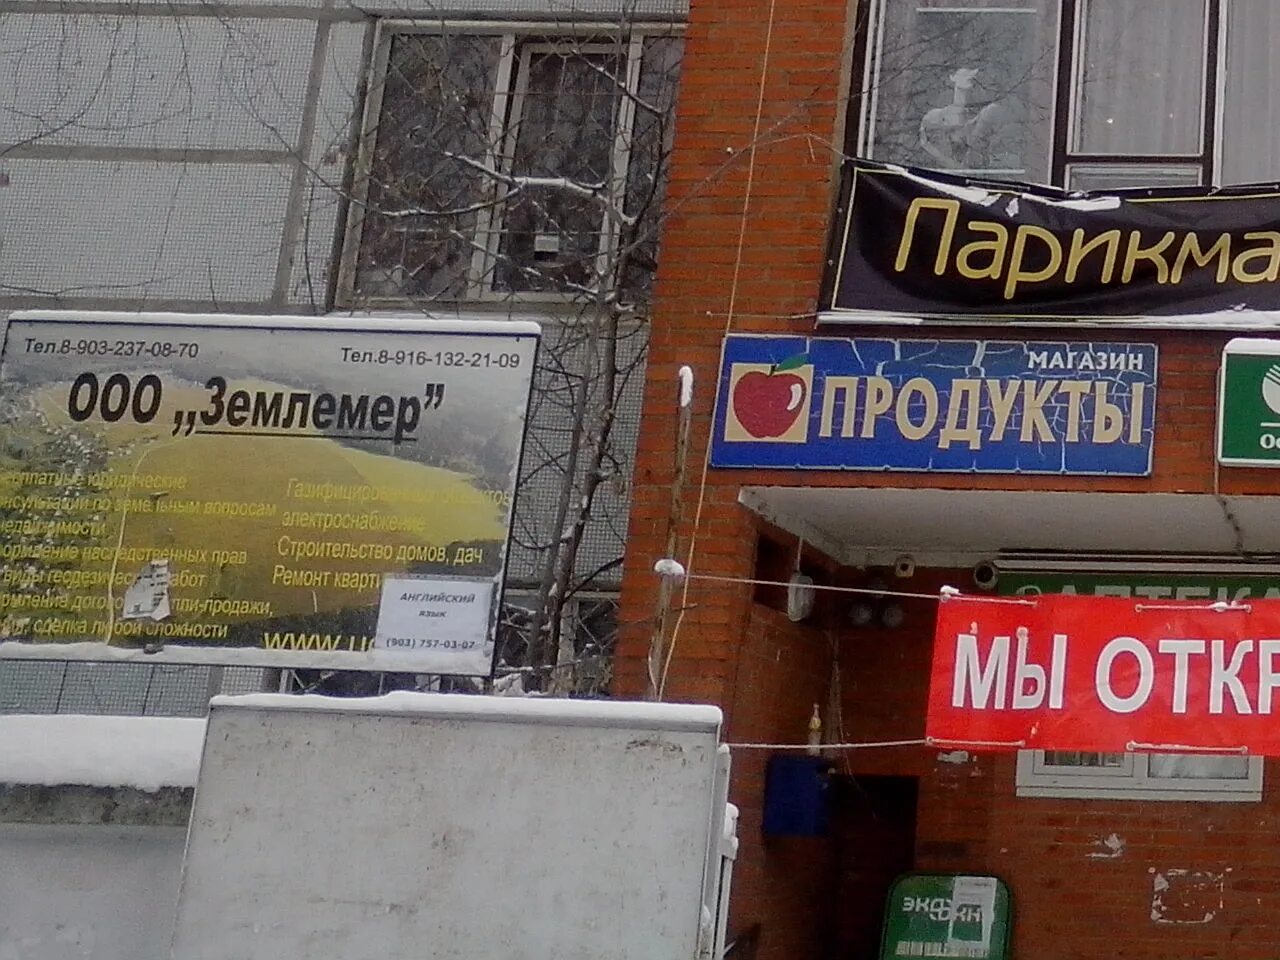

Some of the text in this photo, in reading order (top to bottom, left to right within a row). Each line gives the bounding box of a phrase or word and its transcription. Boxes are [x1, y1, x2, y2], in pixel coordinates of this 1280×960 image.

[25, 338, 199, 358] Тел.8-903-237-08-70
[341, 348, 520, 368] Тел.8-916-132-21-09
[1027, 350, 1144, 371] МАГАЗИН
[68, 372, 163, 424] ООО
[818, 375, 1146, 450] ПРОДУКТЫ
[211, 551, 247, 567] прав
[278, 536, 483, 566] Строительство домов, дач
[169, 570, 206, 588] абот
[272, 564, 333, 586] Ремонт
[400, 592, 476, 604] АНГЛИЙСКИЙ
[951, 634, 1064, 711] МЫ
